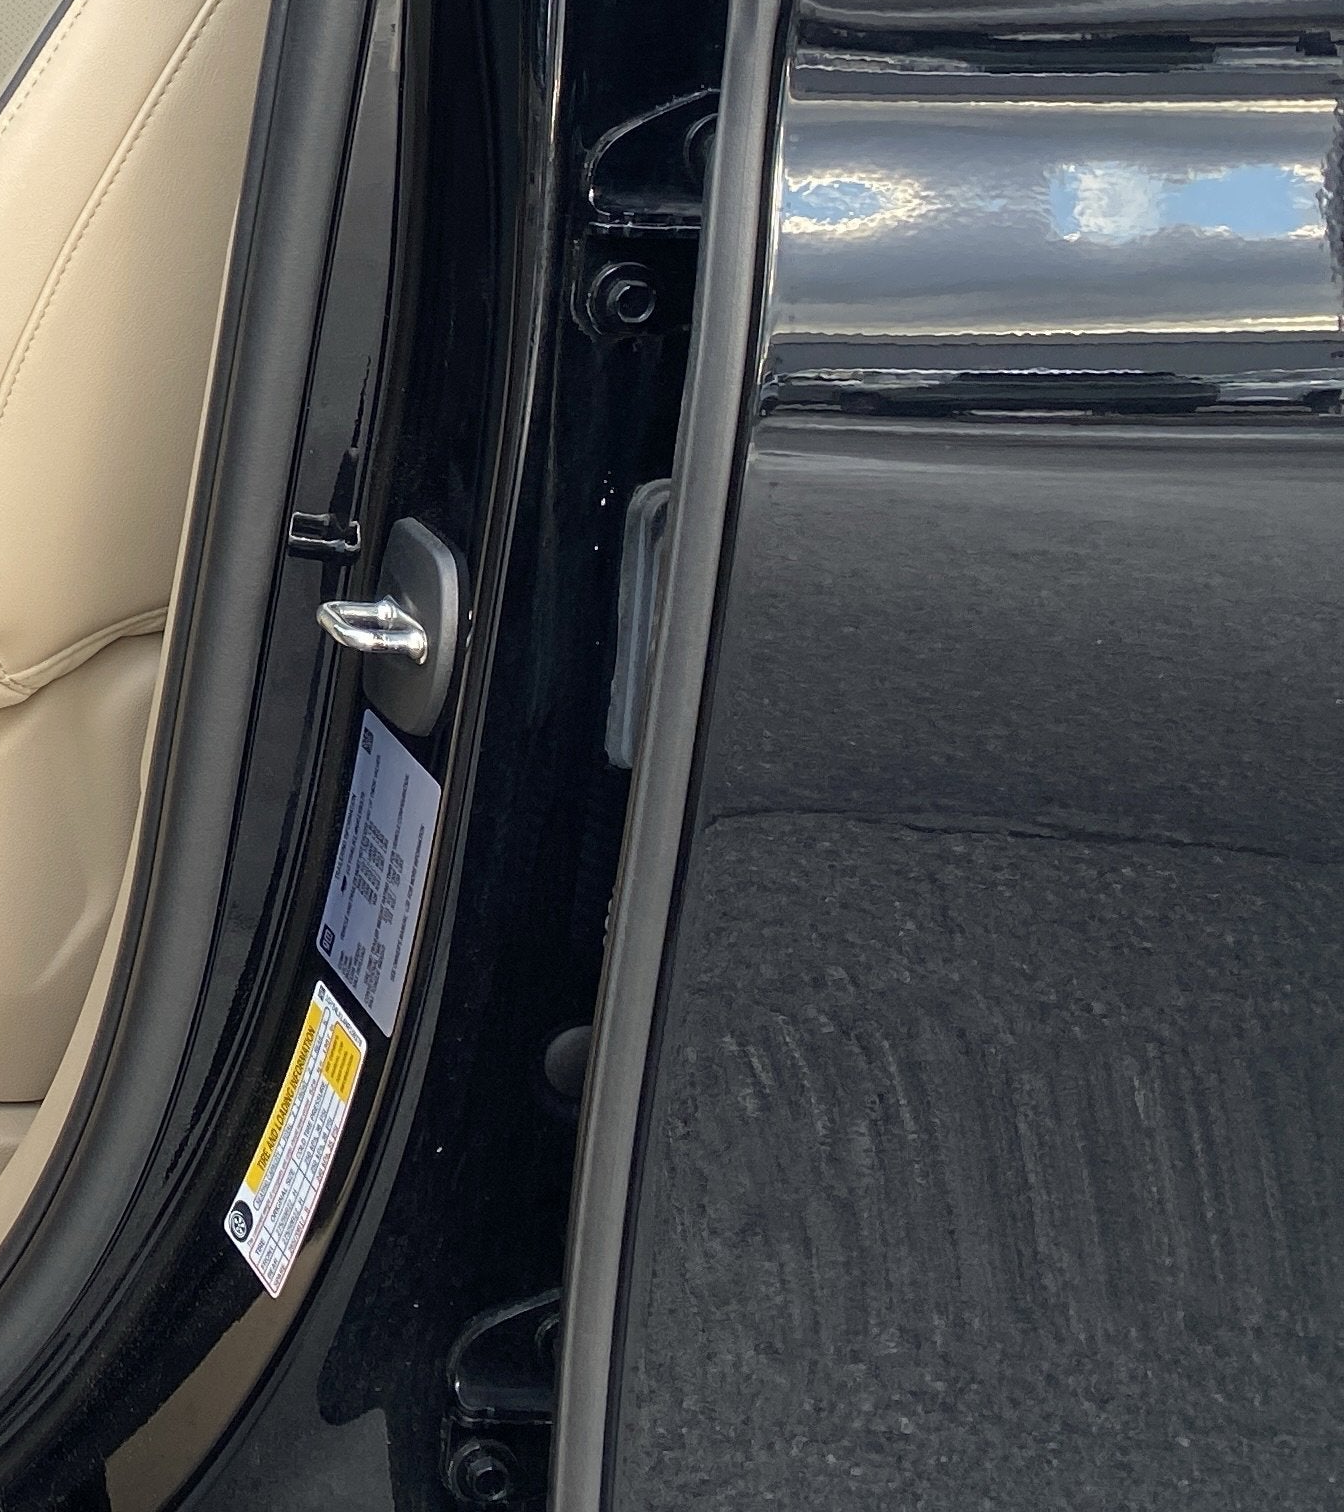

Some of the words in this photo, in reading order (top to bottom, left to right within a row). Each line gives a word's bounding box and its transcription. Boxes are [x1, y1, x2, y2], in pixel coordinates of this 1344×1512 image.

[258, 1148, 269, 1171] TIRE
[267, 1127, 278, 1150] AND
[275, 1089, 293, 1129] LOADING
[290, 1029, 315, 1086] INFORMATION
